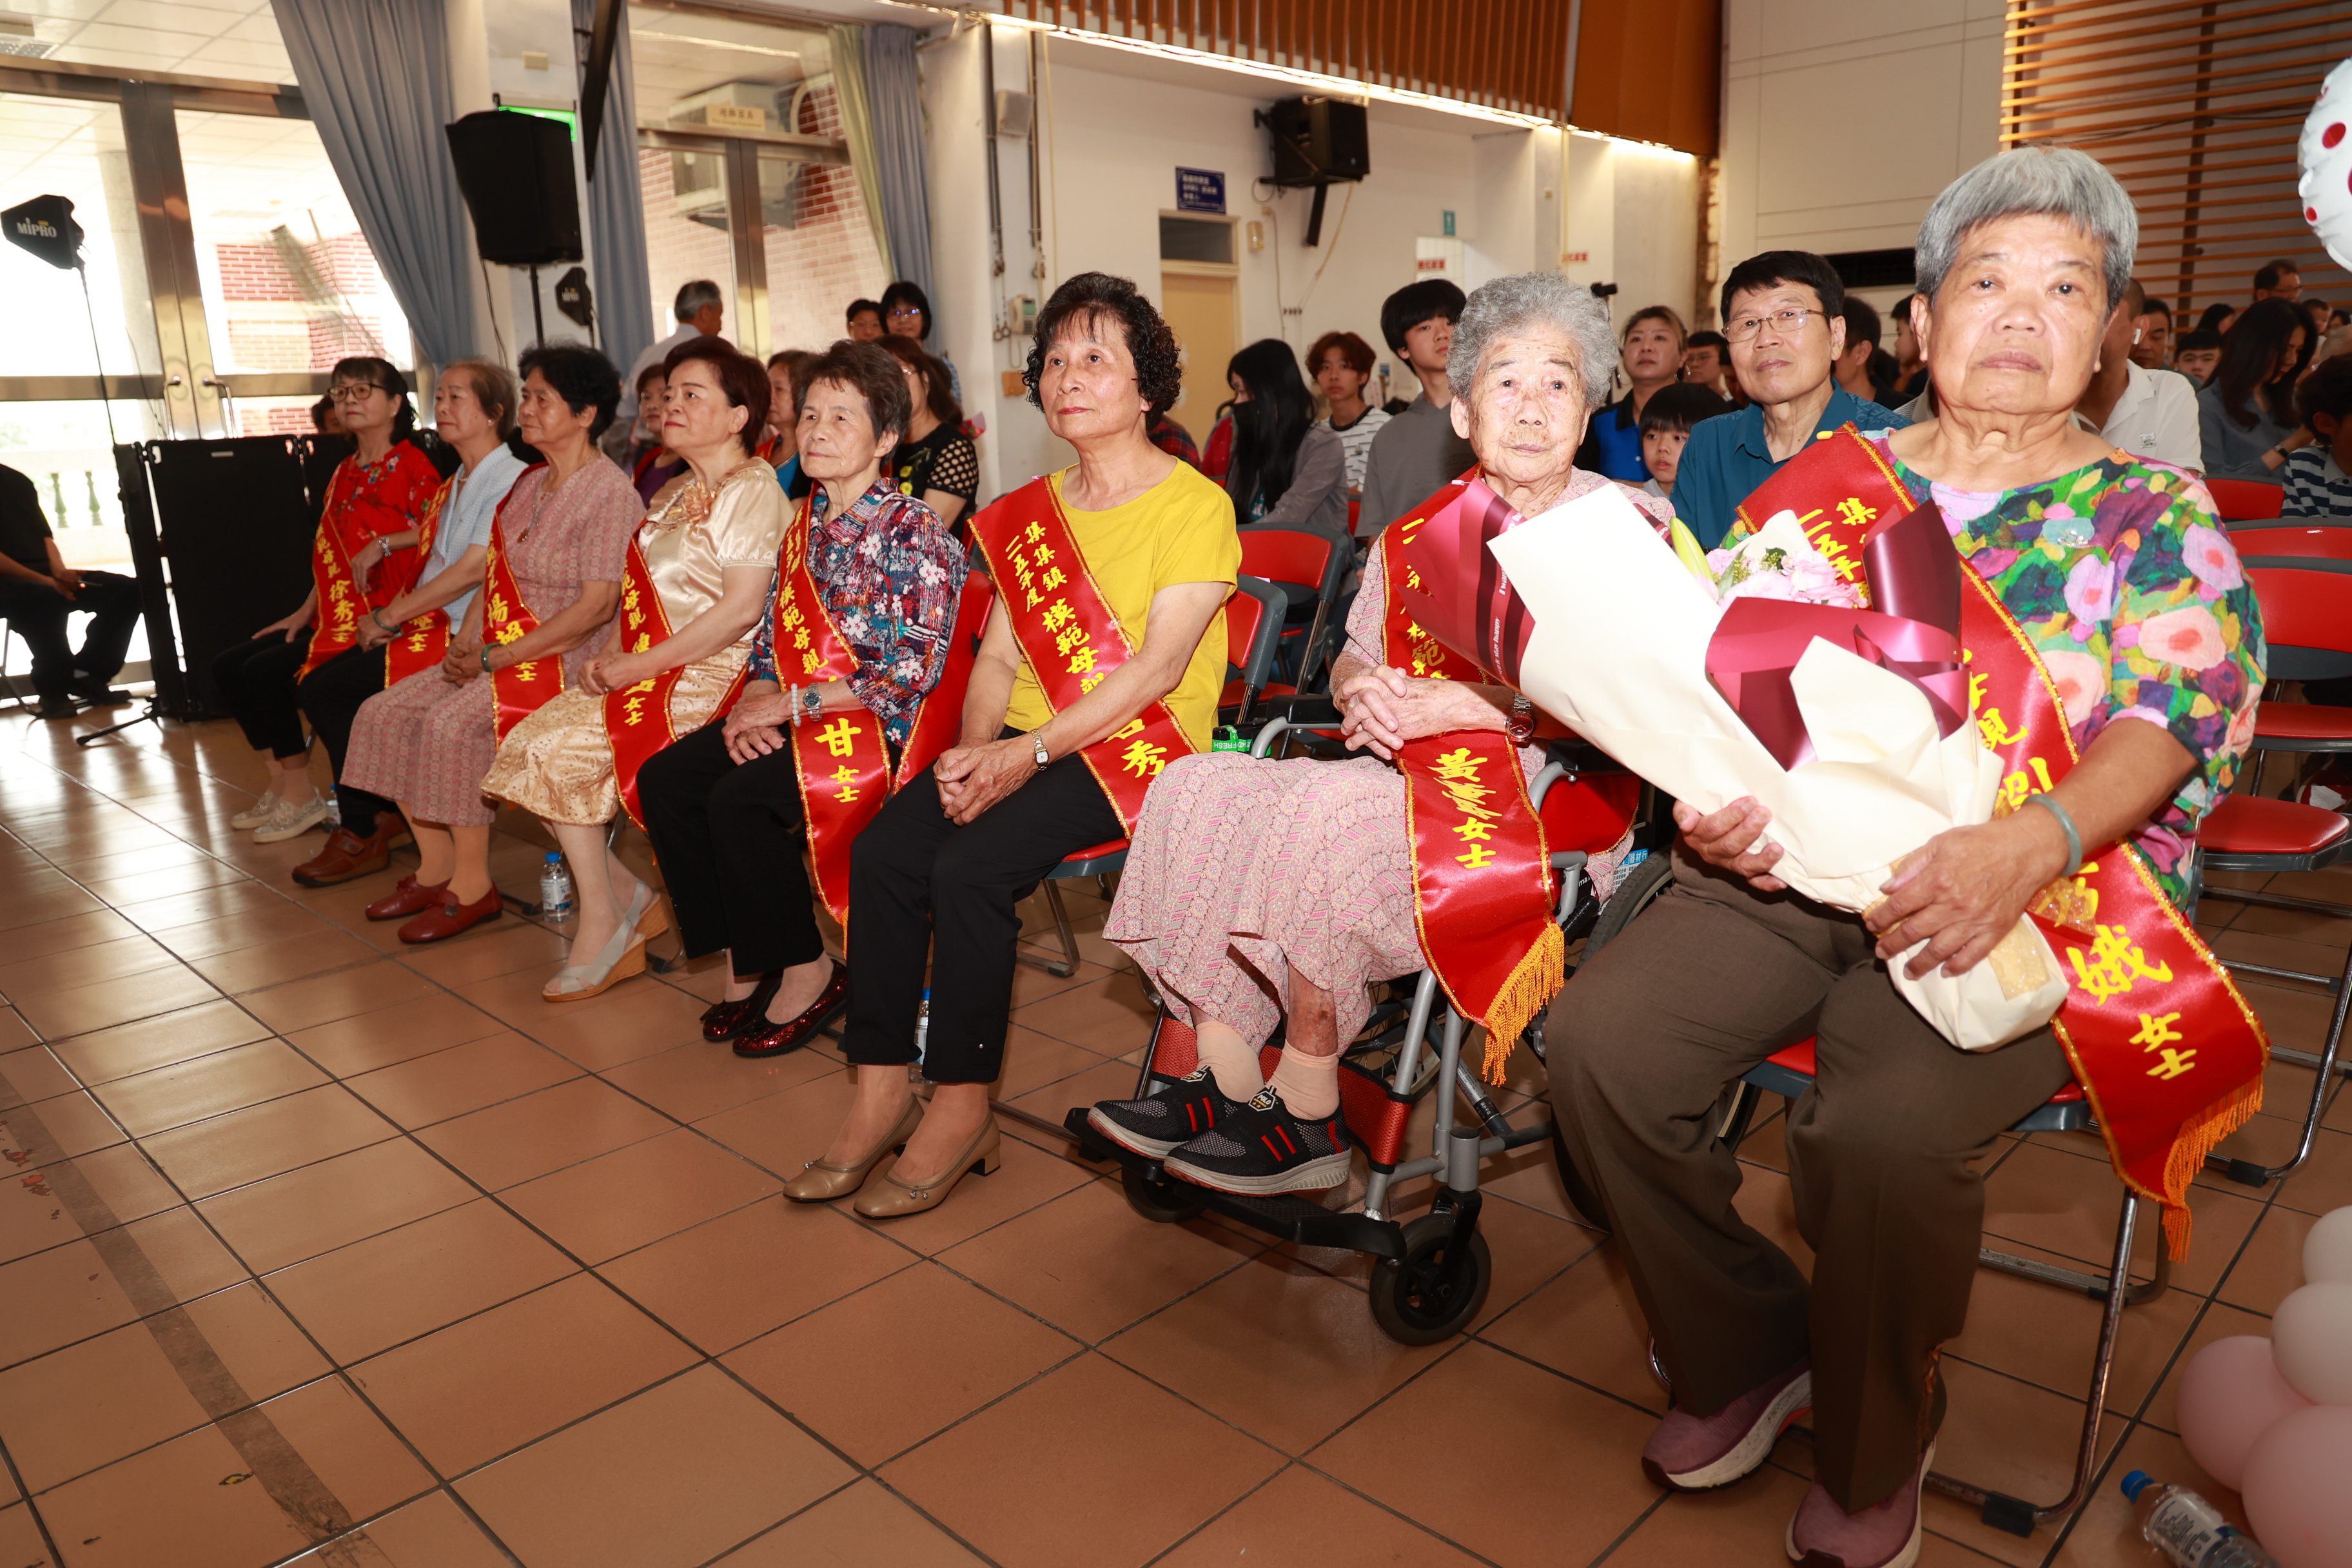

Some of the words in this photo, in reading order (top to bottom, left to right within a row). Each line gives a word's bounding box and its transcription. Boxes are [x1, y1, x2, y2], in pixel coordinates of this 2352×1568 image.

[1024, 521, 1068, 591] 集集鎮
[621, 560, 646, 630] 範母親
[779, 581, 828, 675] 模範母親
[1493, 616, 1502, 643] happy
[1214, 741, 1237, 750] FRESH
[1257, 1093, 1271, 1105] POLO
